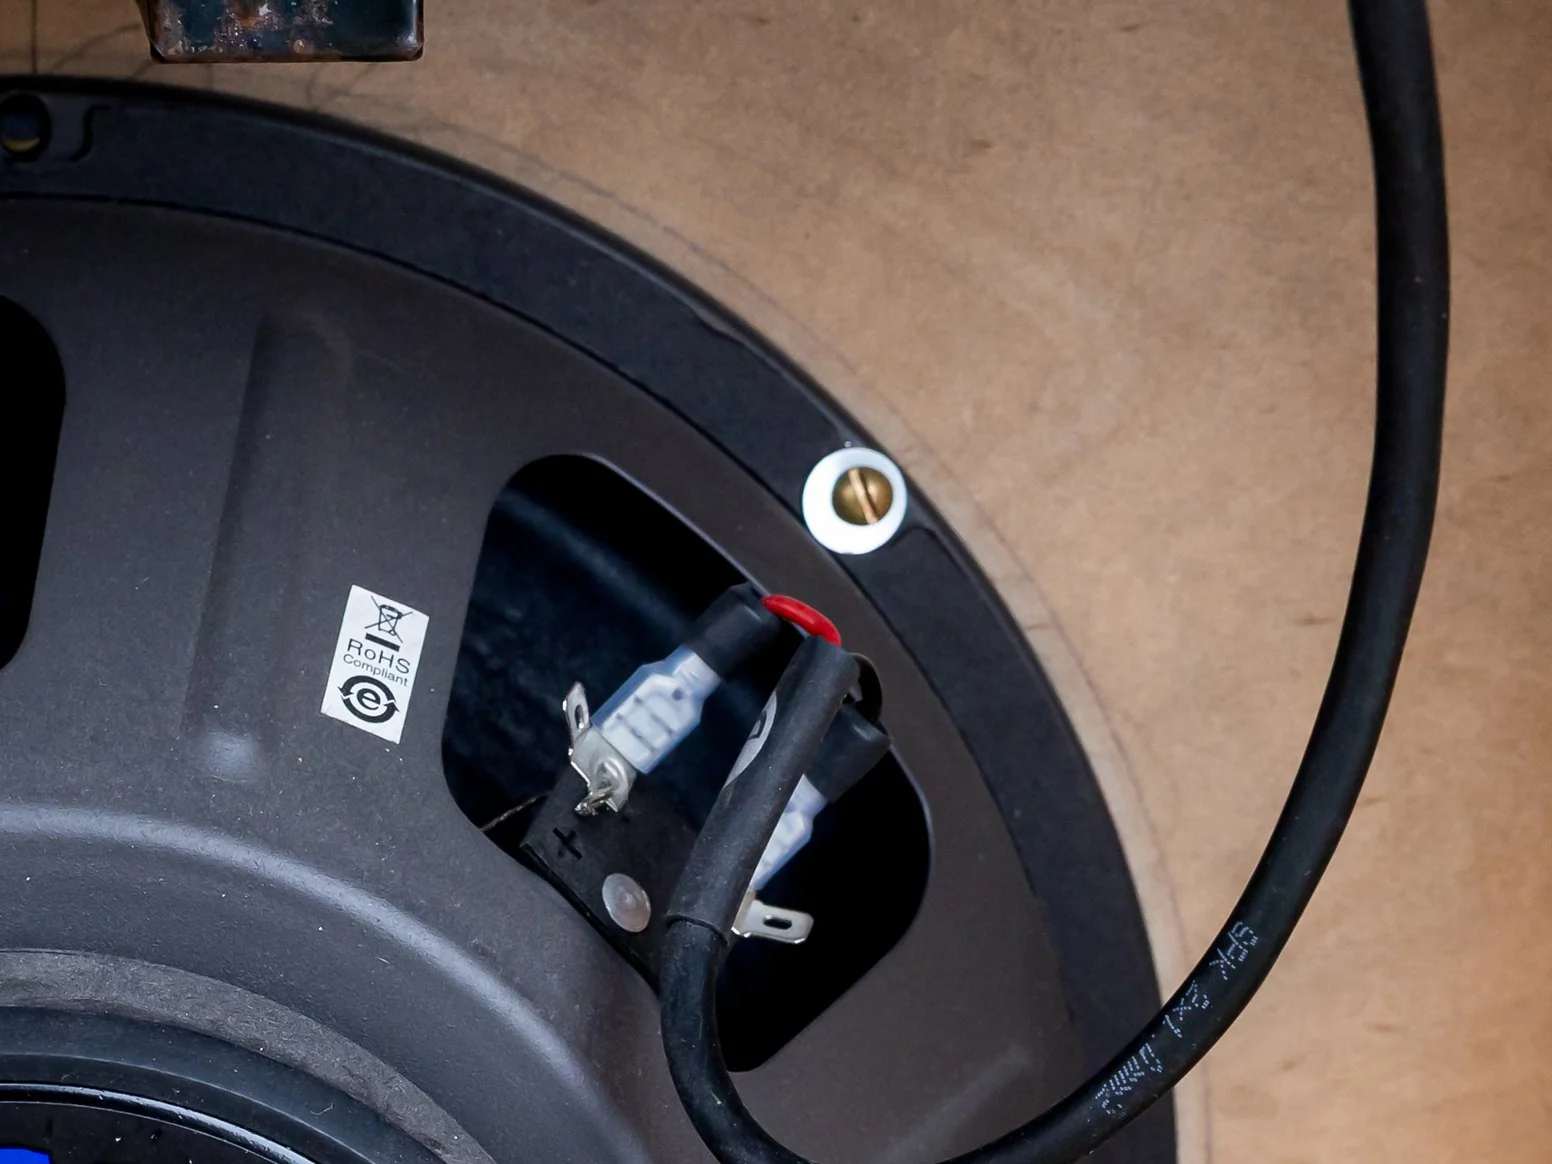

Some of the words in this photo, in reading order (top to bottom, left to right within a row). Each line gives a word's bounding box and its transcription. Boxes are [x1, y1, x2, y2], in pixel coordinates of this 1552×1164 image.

[343, 653, 409, 687] Compliant
[347, 638, 411, 675] RoHS
[1209, 921, 1258, 980] SPK
